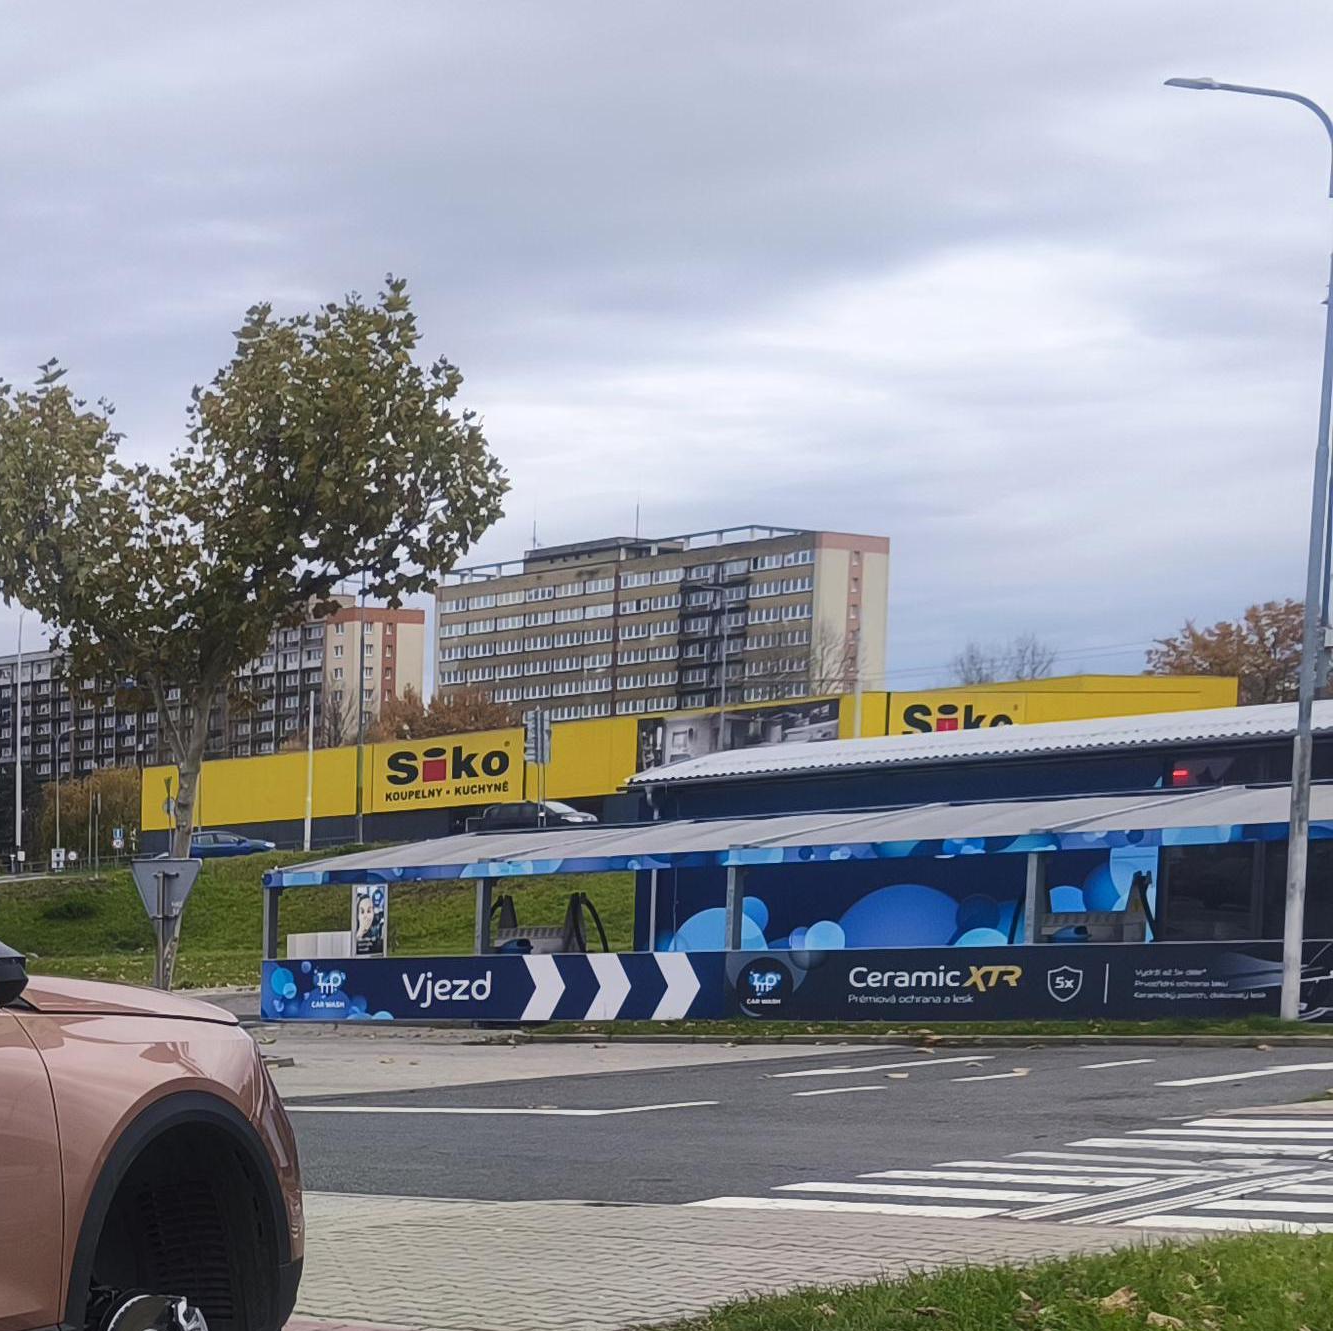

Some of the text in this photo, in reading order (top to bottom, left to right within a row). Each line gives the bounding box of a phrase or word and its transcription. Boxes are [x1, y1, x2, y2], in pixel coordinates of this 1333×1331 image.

[386, 745, 510, 785] Siko
[385, 788, 443, 802] KOUPELNY
[848, 965, 1022, 992] Ceramic XTR
[1054, 976, 1074, 989] 5x
[402, 970, 492, 1009] Vjezd
[848, 994, 896, 1004] Prémiová
[898, 994, 941, 1004] ochrana
[943, 996, 951, 1004] a
